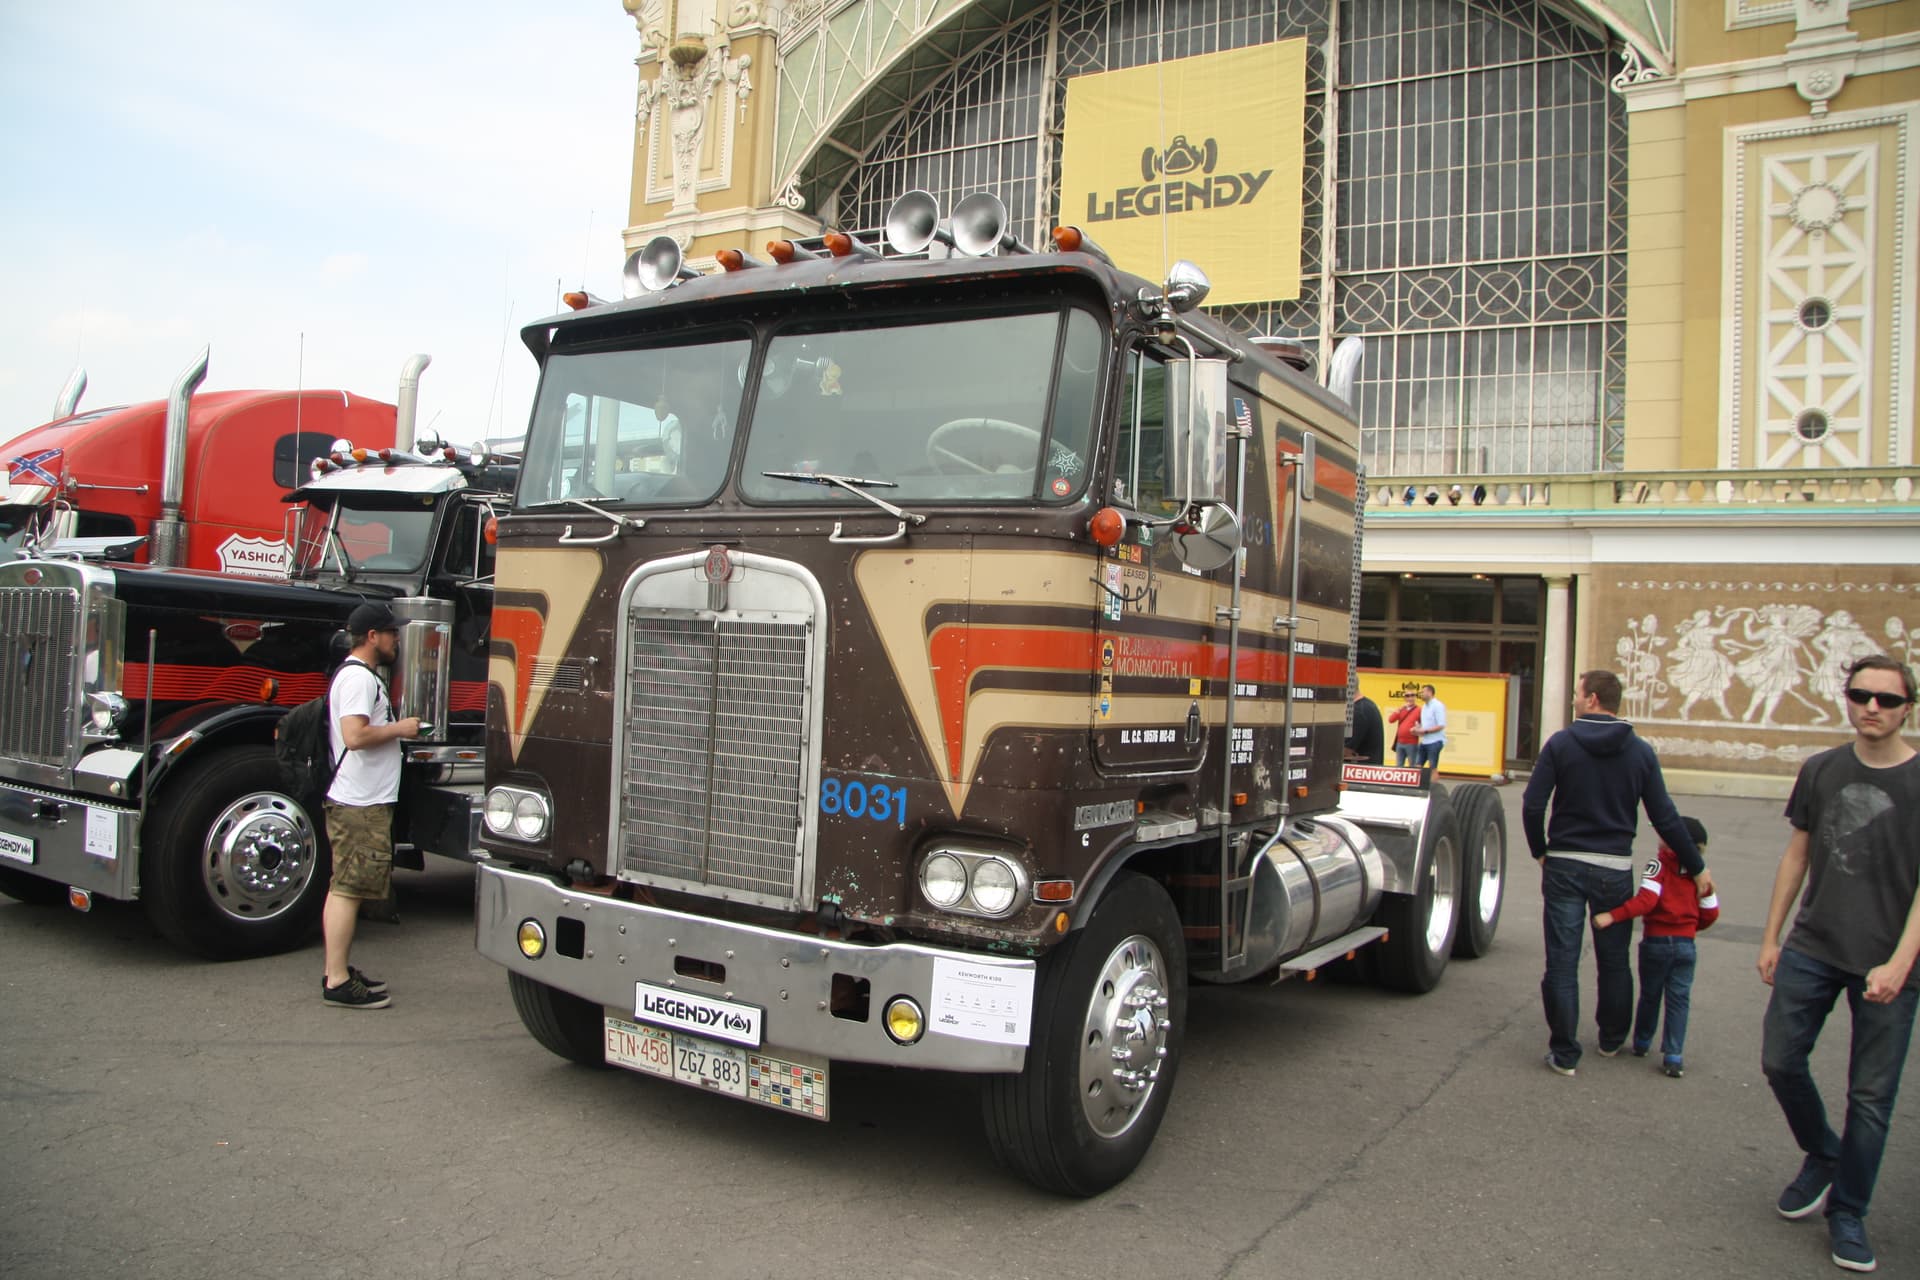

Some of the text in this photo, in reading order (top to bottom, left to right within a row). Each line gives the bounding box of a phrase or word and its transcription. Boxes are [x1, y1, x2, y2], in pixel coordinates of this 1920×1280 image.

[1087, 169, 1273, 222] LEGENDY
[231, 549, 285, 564] YASHICA
[1123, 568, 1146, 580] LEASED
[1346, 767, 1418, 783] KENWORTH
[820, 776, 908, 827] 8031
[644, 993, 724, 1026] LEGENDY
[679, 1048, 707, 1077] ZGZ
[712, 1057, 741, 1085] 883
